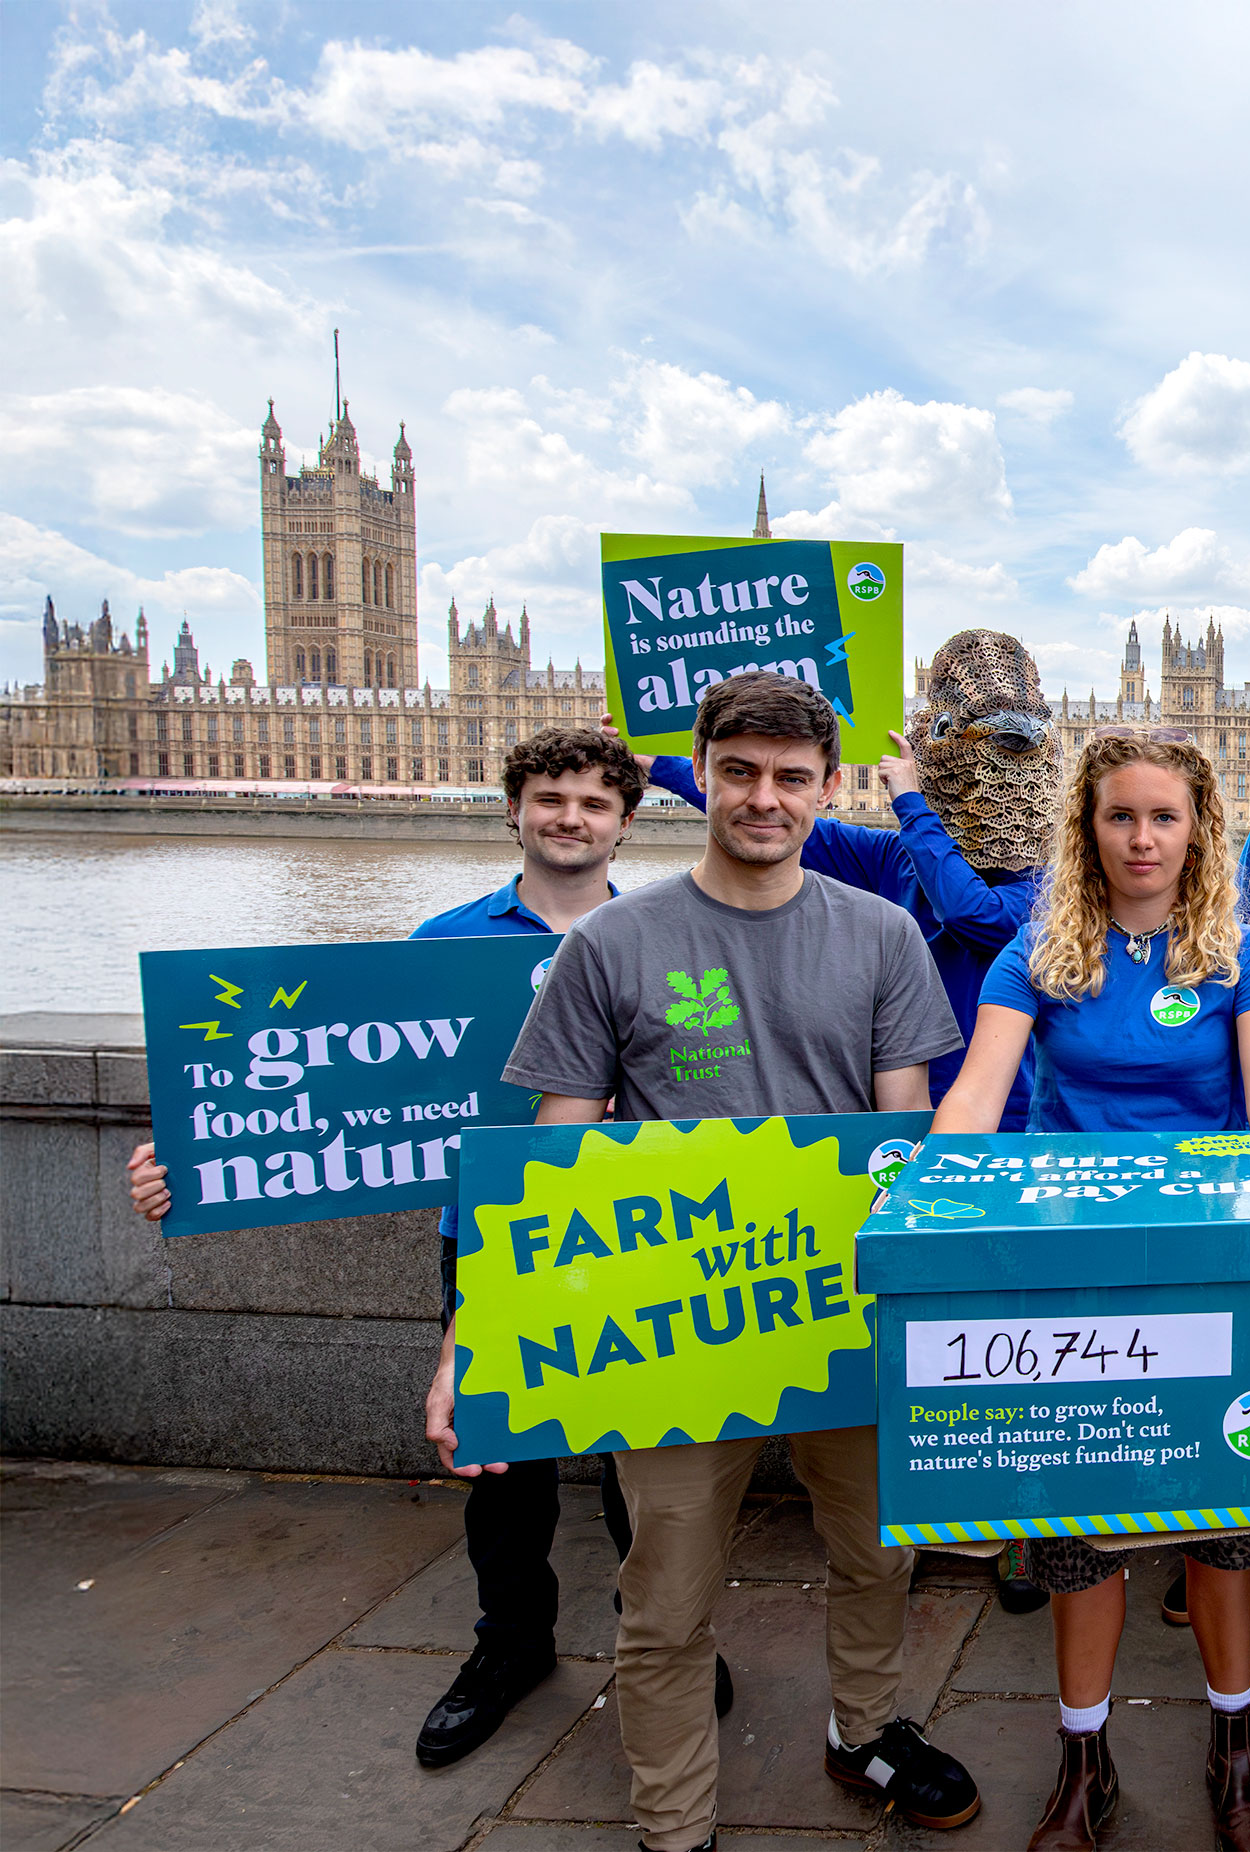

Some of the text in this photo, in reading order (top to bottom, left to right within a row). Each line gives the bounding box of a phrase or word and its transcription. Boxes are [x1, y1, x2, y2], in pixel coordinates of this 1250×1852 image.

[619, 572, 809, 625] Nature
[854, 585, 880, 596] RSPB
[630, 613, 815, 655] is sounding the
[1159, 1010, 1191, 1019] RSPB
[184, 1016, 475, 1091] To grow
[669, 1039, 751, 1064] National
[669, 1064, 722, 1082] Trust
[189, 1091, 480, 1141] food, we need
[193, 1129, 461, 1205] natur
[879, 1171, 901, 1183] RS
[919, 1168, 1203, 1184] can't afford a
[927, 1152, 1169, 1171] Nature
[1016, 1181, 1154, 1204] pay
[509, 1177, 735, 1276] FARM
[691, 1207, 821, 1281] with
[517, 1263, 851, 1390] NATURE
[942, 1328, 1159, 1382] 106,744
[909, 1395, 1164, 1426] People say: to grow food,
[909, 1420, 1171, 1448] we need nature. Don't cut
[909, 1441, 1201, 1473] nature's biggest funding pot!
